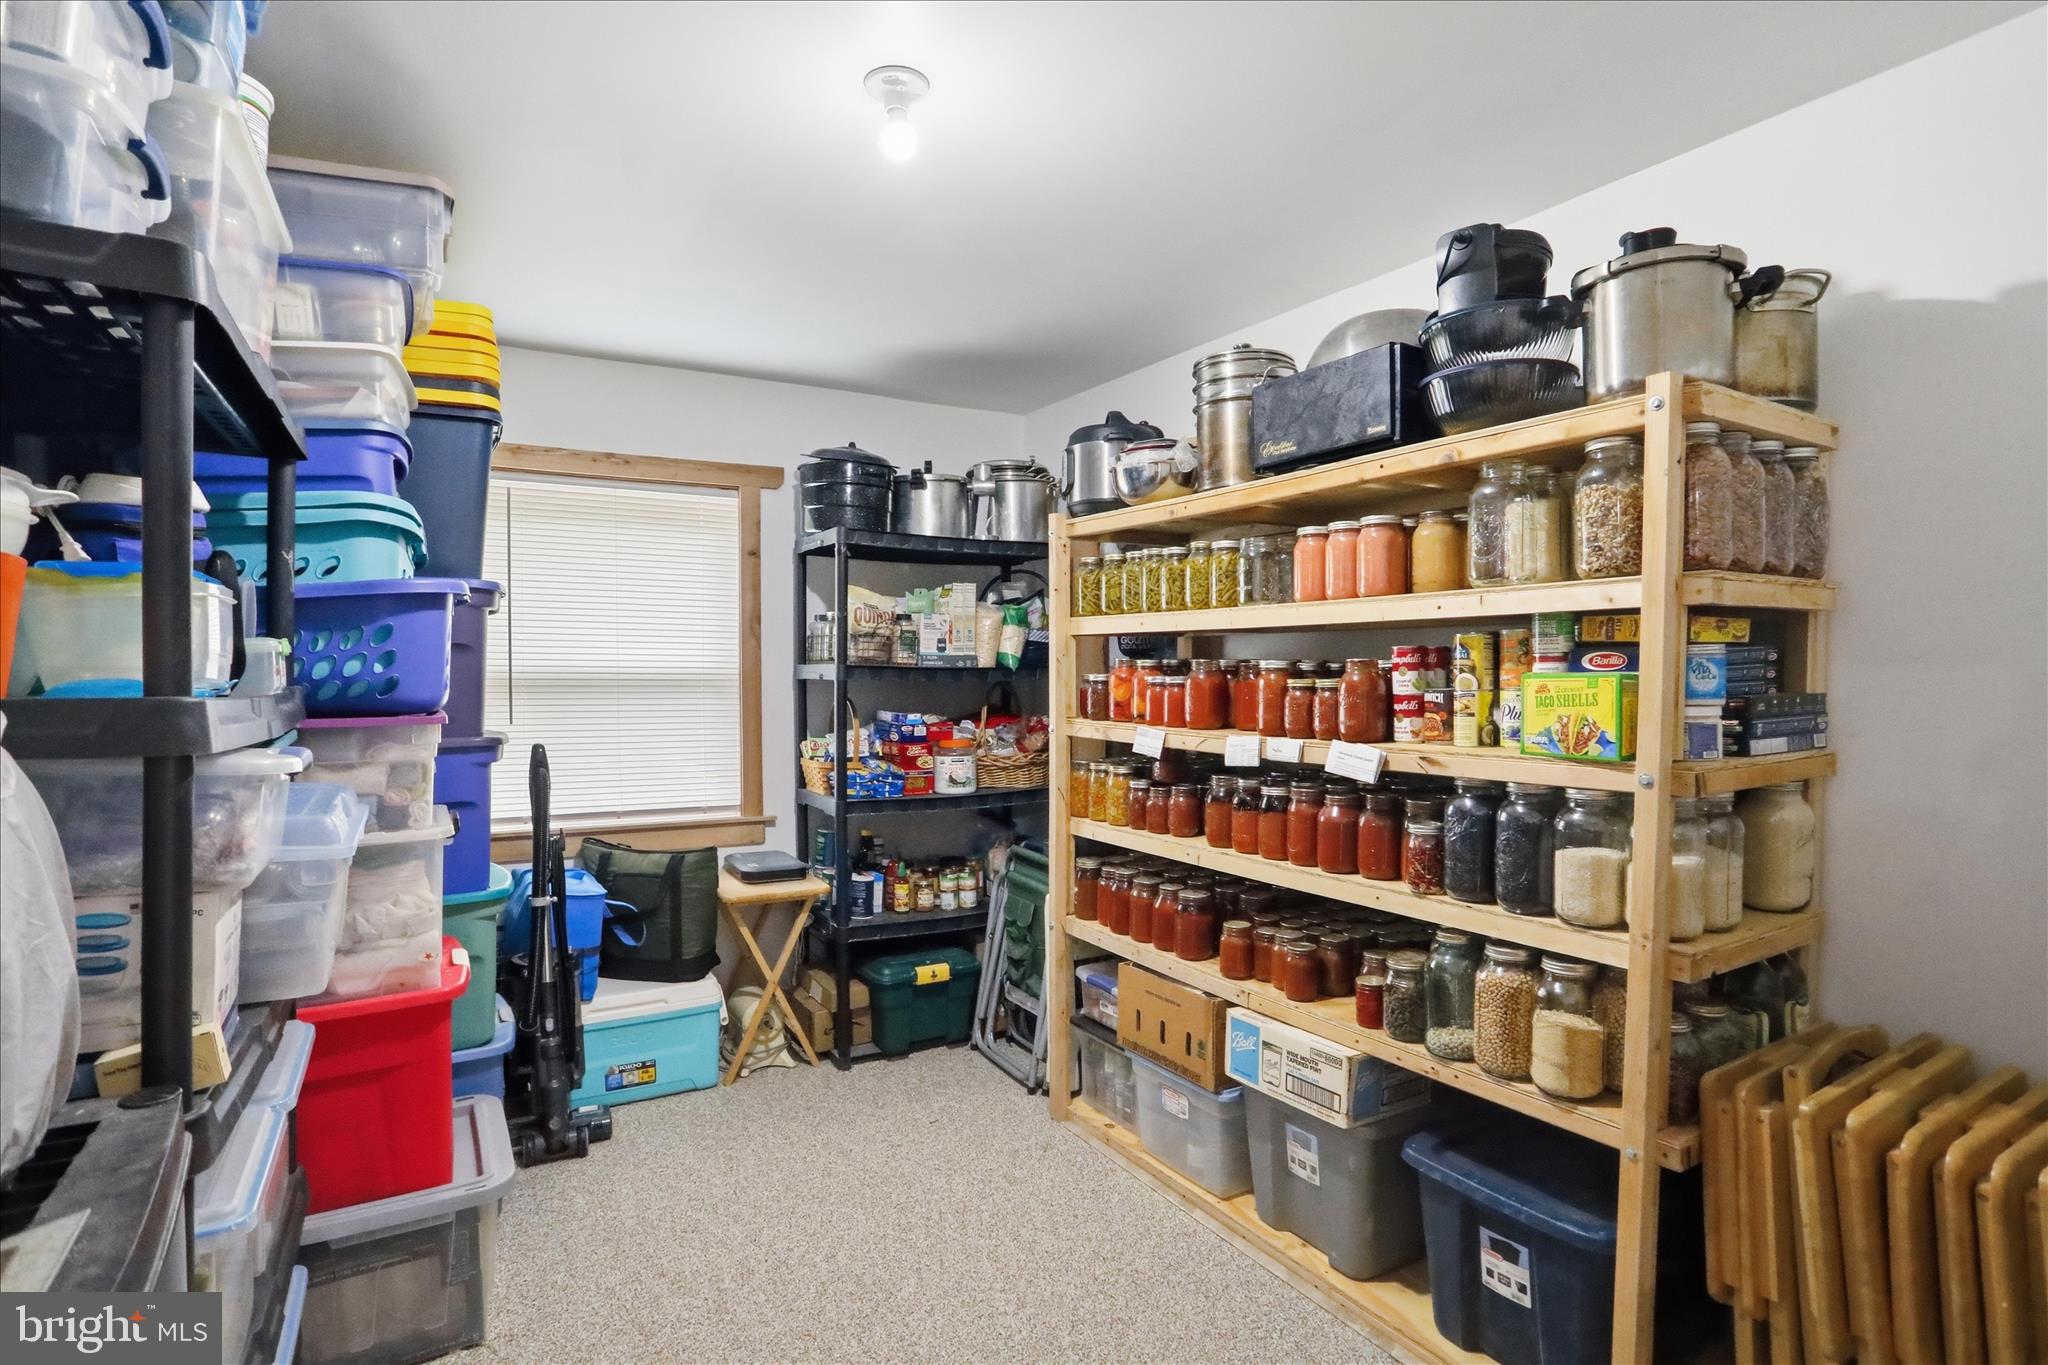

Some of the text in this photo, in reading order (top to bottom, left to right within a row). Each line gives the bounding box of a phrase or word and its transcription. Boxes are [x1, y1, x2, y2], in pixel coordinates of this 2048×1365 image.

[1591, 655, 1624, 666] Barilla
[1535, 692, 1598, 709] TACO SHELLS
[1232, 1031, 1257, 1052] Ball
[619, 1062, 642, 1070] IGLOO
[1286, 1050, 1300, 1060] WIDE
[1300, 1055, 1319, 1067] MOUTH
[1286, 1056, 1309, 1070] TAPERED
[1310, 1065, 1322, 1075] PINT
